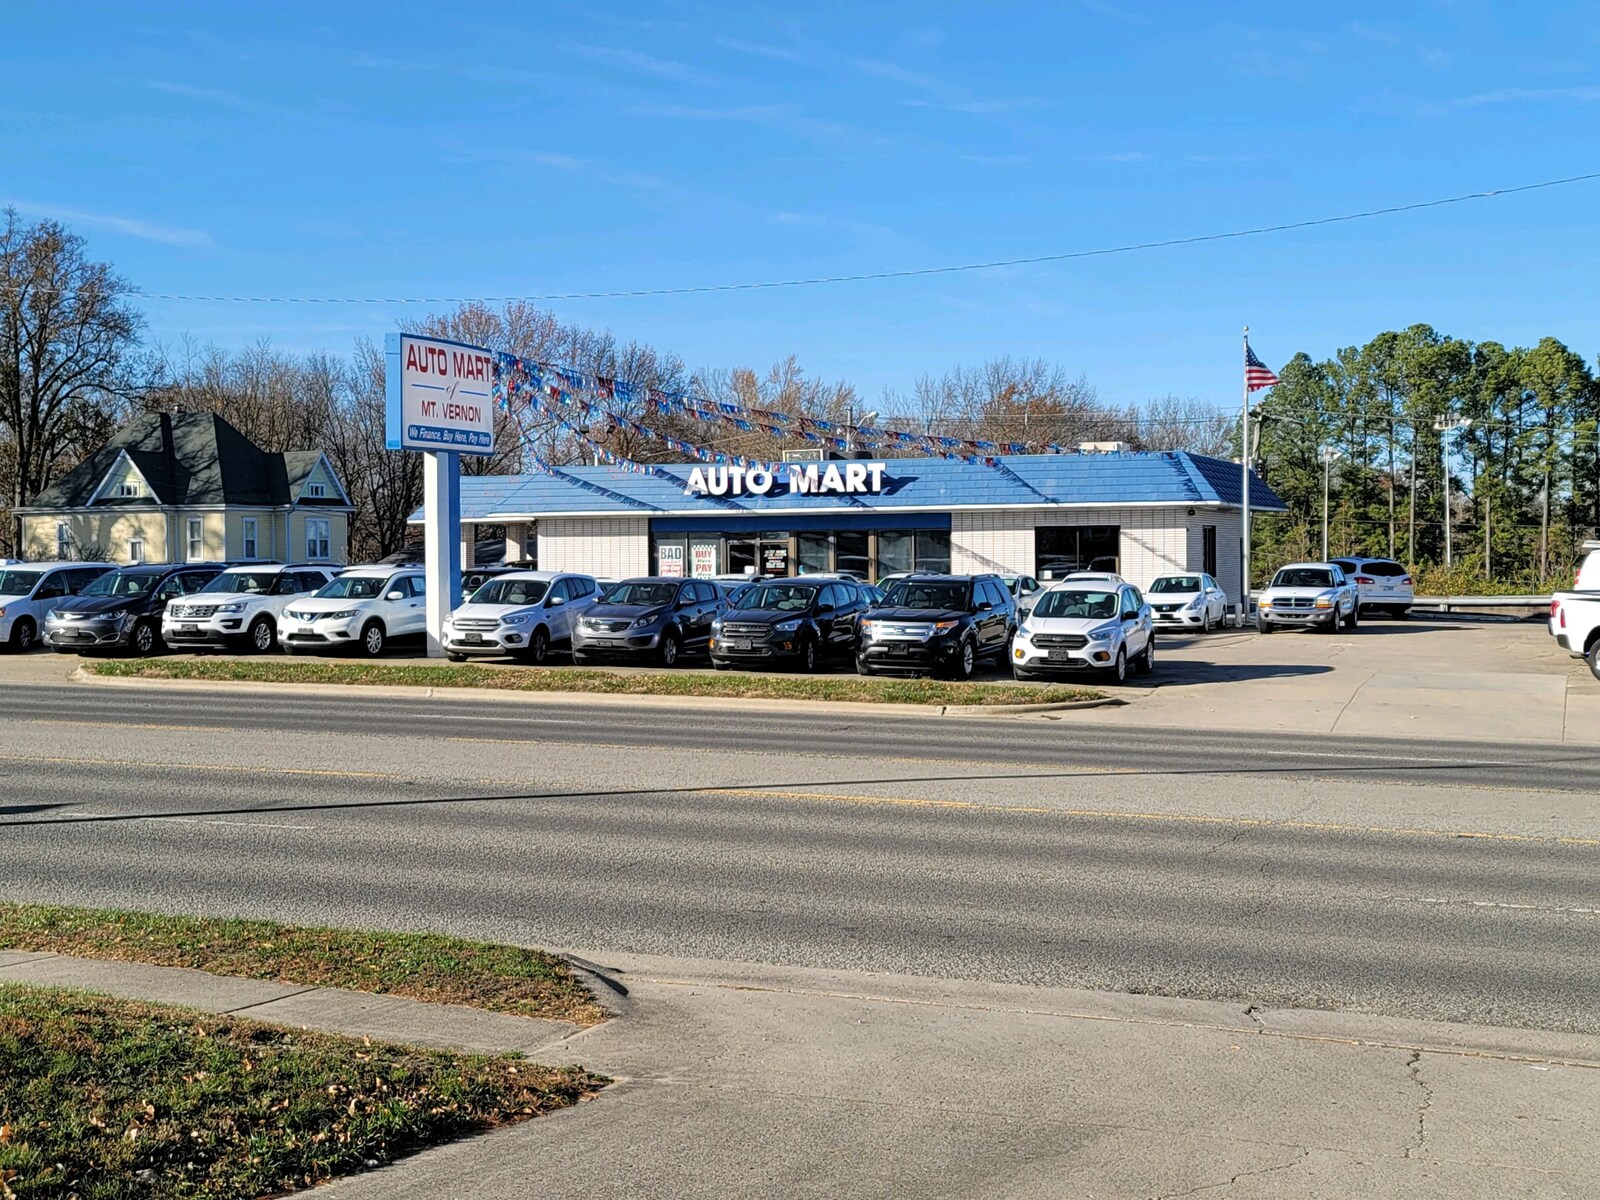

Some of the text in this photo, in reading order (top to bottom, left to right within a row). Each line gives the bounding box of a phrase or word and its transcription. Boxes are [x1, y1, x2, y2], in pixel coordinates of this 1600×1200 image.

[406, 344, 491, 382] AUTO MART
[446, 381, 460, 400] of
[421, 400, 481, 423] MT. VERNON
[409, 427, 419, 438] We
[443, 430, 454, 442] Buy
[469, 432, 479, 445] Pay
[479, 434, 490, 445] Here
[685, 463, 885, 495] AUTO MART
[660, 547, 682, 560] BAD
[695, 550, 712, 558] BUY
[696, 564, 713, 572] PAY
